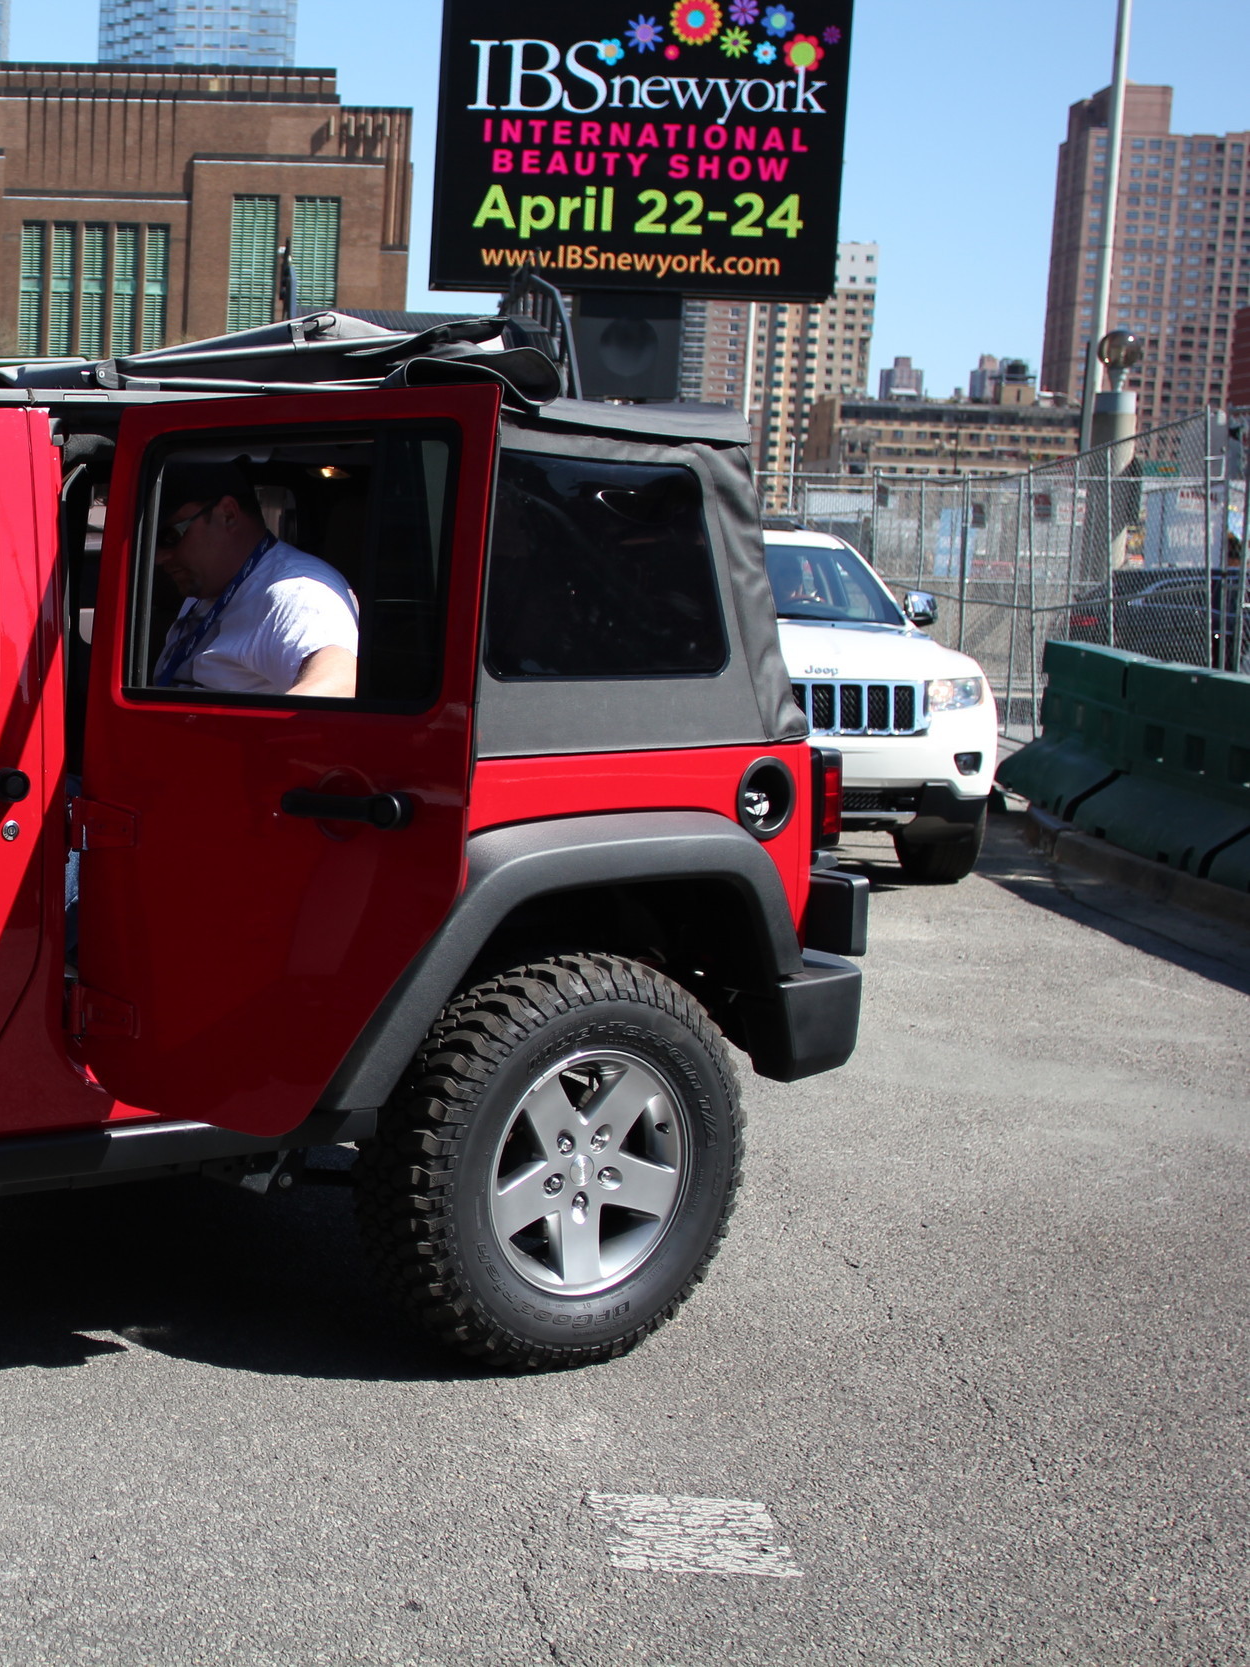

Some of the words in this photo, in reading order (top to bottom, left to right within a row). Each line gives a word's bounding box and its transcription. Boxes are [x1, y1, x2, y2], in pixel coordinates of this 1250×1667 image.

[483, 118, 809, 153] INTERNATIONAL
[492, 149, 648, 178] BEAUTY
[668, 154, 790, 182] SHOW
[472, 184, 614, 239] April
[634, 189, 803, 239] 22-24
[481, 245, 781, 278] www.IBSnewyork.com
[805, 665, 839, 677] Jeep
